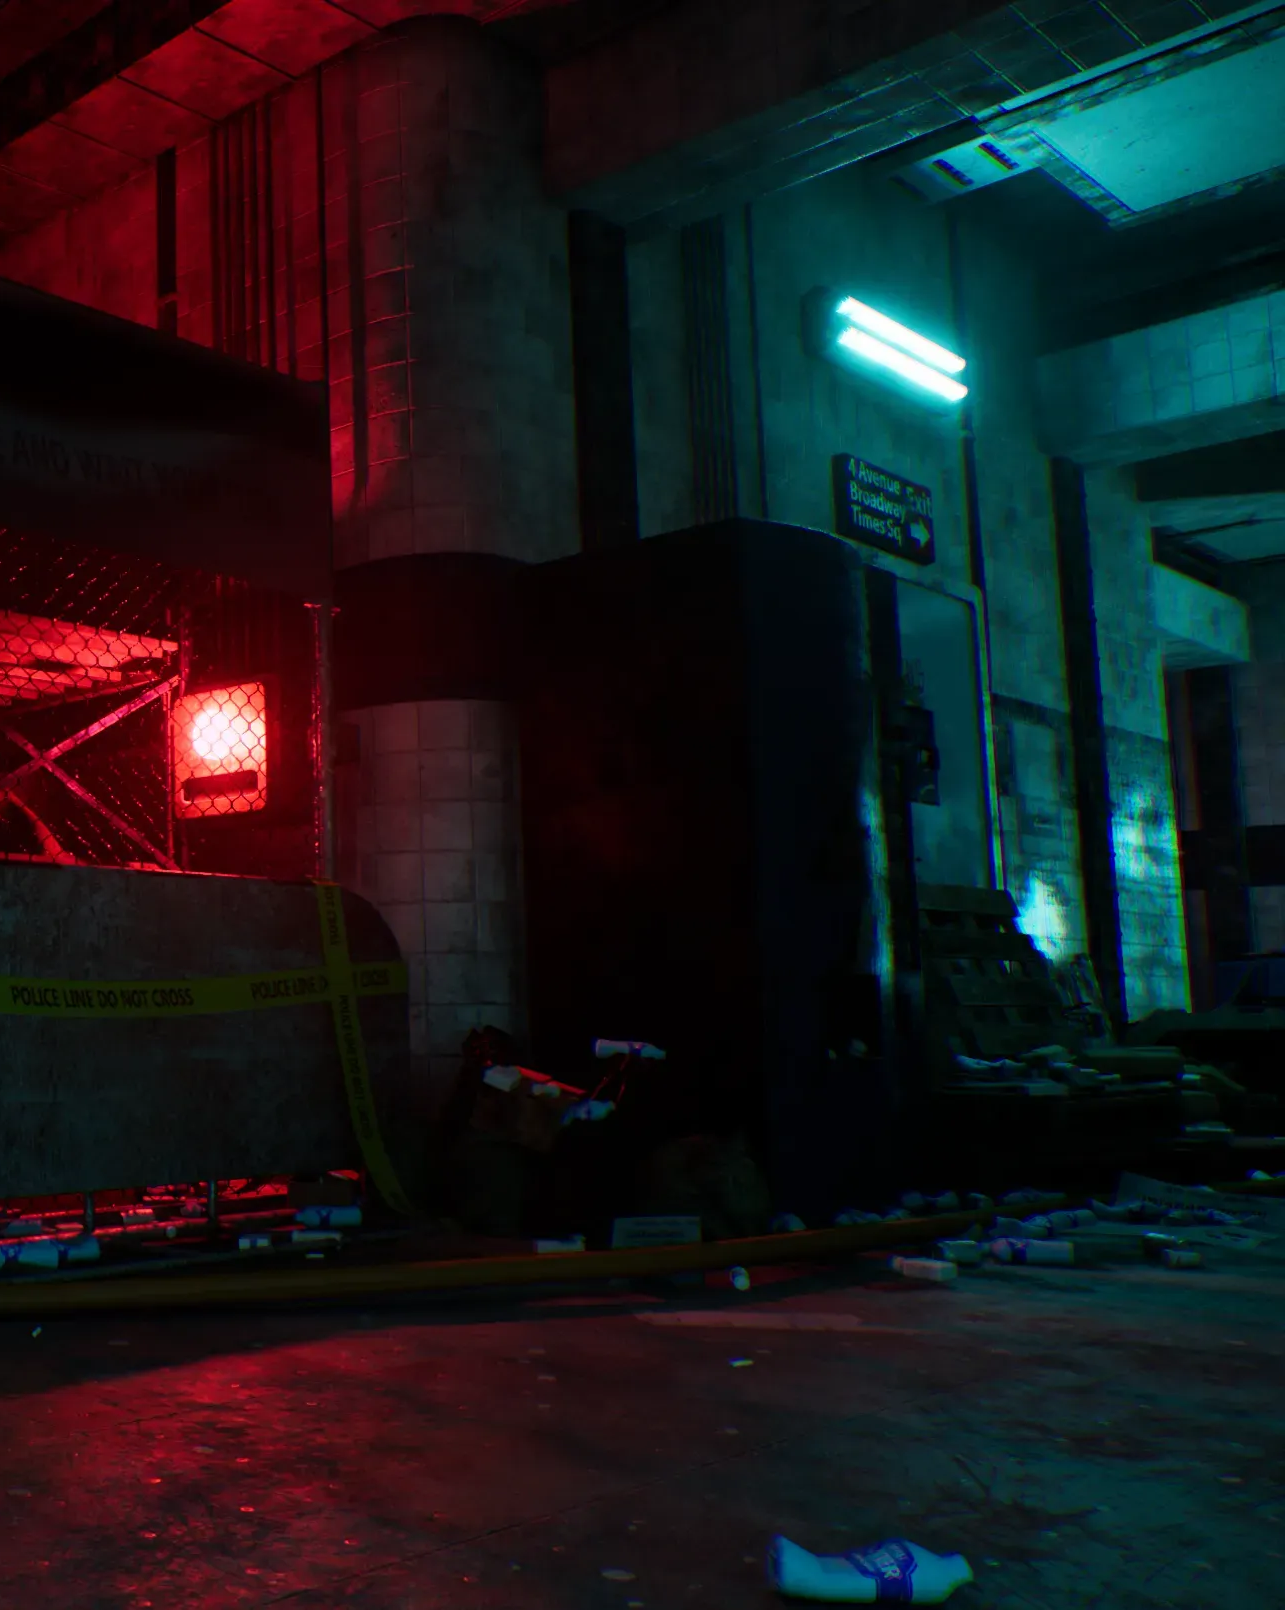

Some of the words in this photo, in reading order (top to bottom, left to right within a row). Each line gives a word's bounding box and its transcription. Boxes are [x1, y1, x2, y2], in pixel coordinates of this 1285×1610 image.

[858, 460, 901, 496] Avenue
[849, 479, 906, 525] Broadway
[11, 983, 61, 1007] POLICE
[64, 986, 94, 1008] LINE
[96, 989, 119, 1008] DO
[121, 986, 149, 1008] NOT
[150, 986, 196, 1007] CROSS
[249, 978, 293, 1000] POLICE
